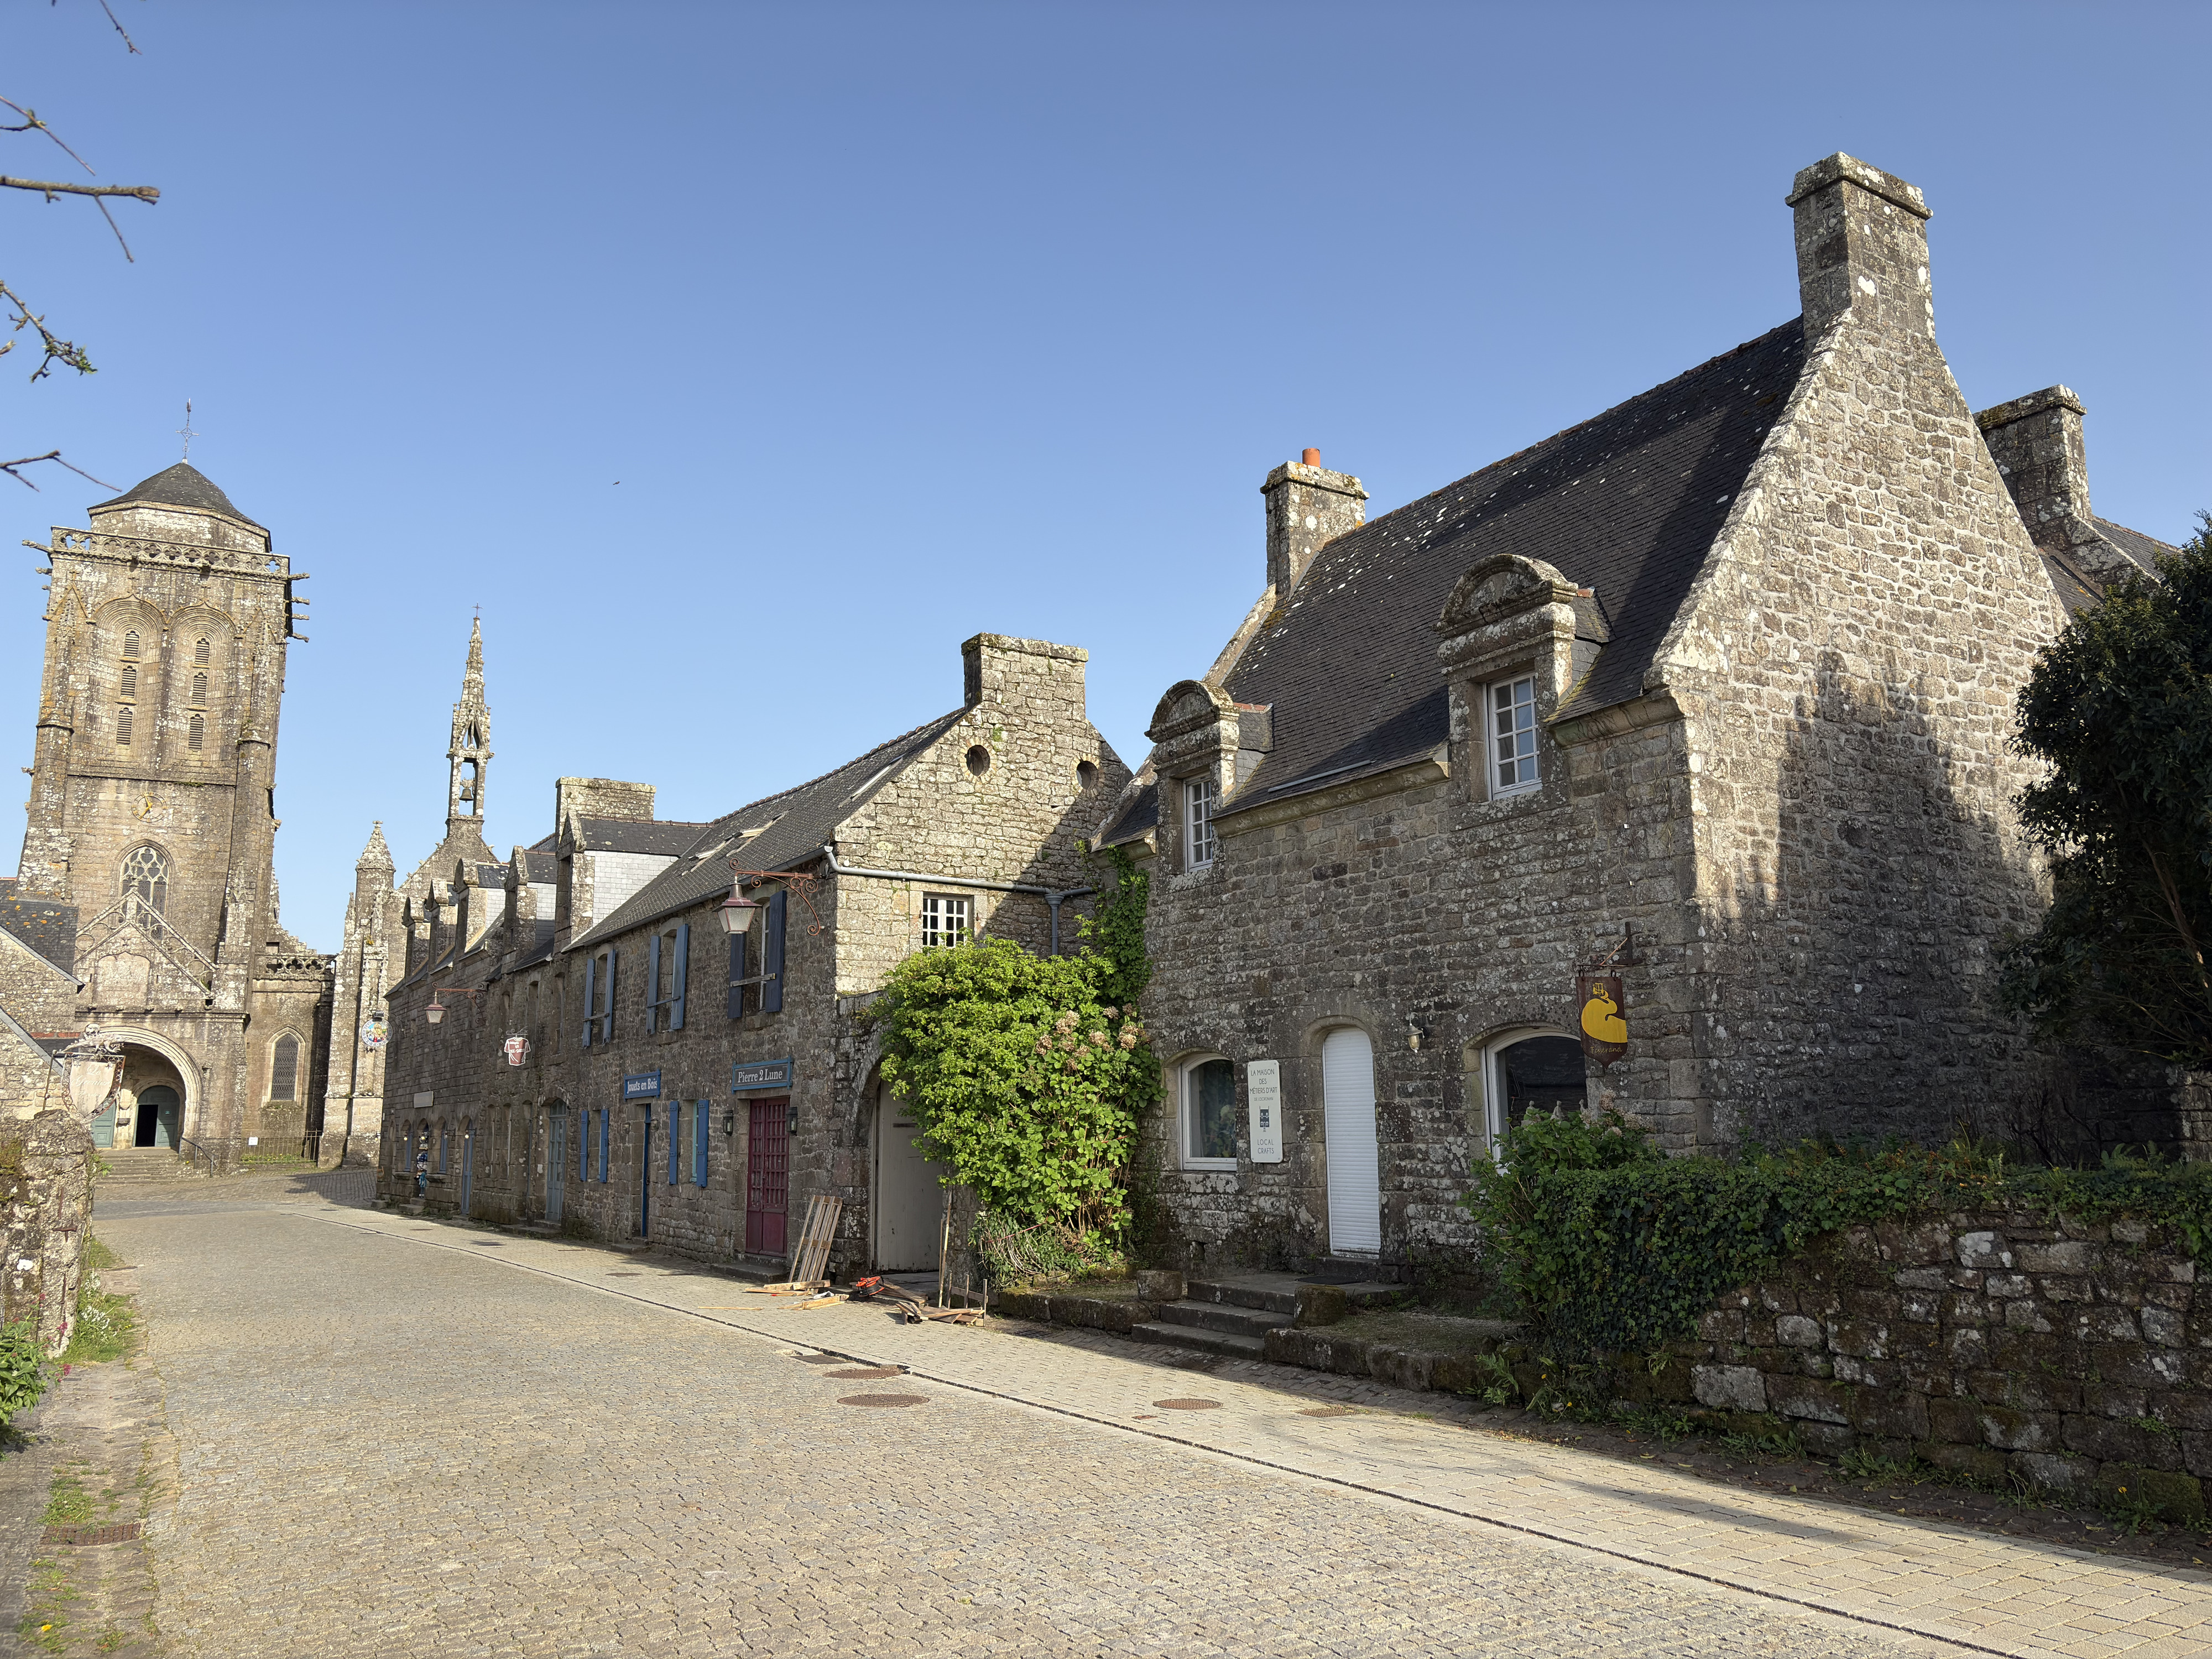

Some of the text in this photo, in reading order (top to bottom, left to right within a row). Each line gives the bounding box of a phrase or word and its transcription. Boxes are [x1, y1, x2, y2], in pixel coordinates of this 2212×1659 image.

[1590, 1046, 1623, 1054] Tisserand
[86, 1065, 102, 1076] Le
[737, 1068, 782, 1083] Pierre 2 Lune
[627, 1078, 658, 1094] Jouets en Bois
[1249, 1086, 1266, 1094] MÉTIERS
